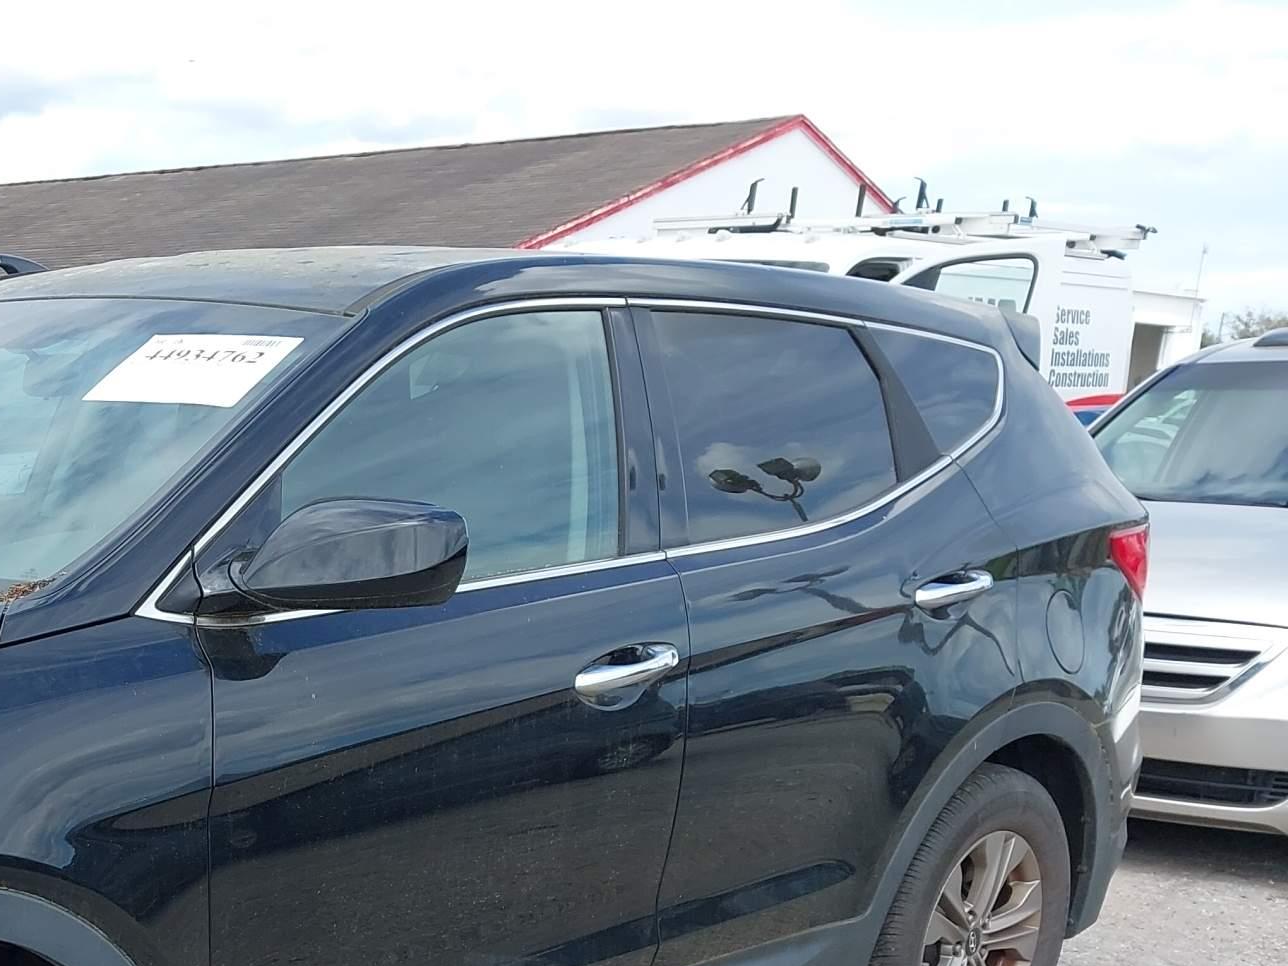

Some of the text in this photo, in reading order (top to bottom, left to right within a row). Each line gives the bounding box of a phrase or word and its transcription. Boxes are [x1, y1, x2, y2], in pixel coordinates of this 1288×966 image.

[1052, 326, 1080, 346] Sales
[145, 349, 265, 364] 44934762
[1050, 348, 1111, 368] Installations
[1048, 368, 1110, 388] Construction
